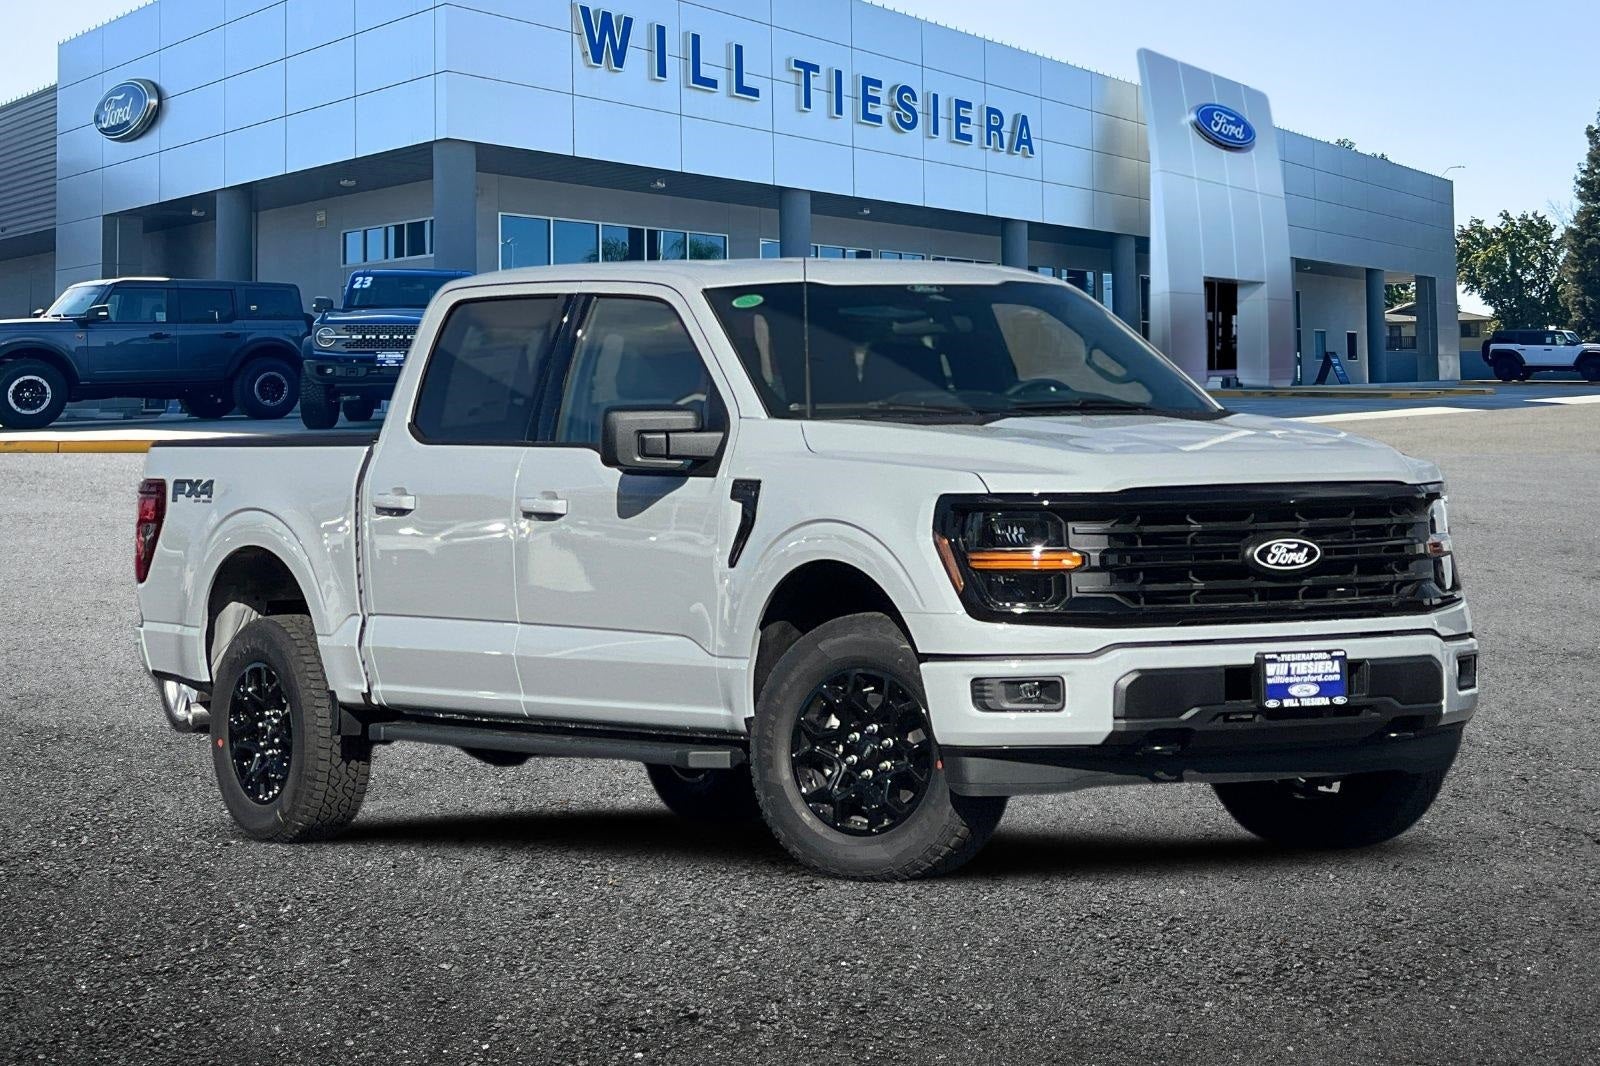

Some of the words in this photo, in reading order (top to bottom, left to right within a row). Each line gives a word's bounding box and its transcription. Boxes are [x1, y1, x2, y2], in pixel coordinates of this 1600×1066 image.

[573, 2, 760, 101] WILL
[787, 56, 1035, 157] TIESIERA
[102, 93, 133, 129] Ford
[1211, 111, 1245, 139] Ford
[352, 276, 374, 289] 23
[172, 479, 214, 502] FX4
[1267, 543, 1308, 564] Ford
[1290, 660, 1341, 675] TIESIERA
